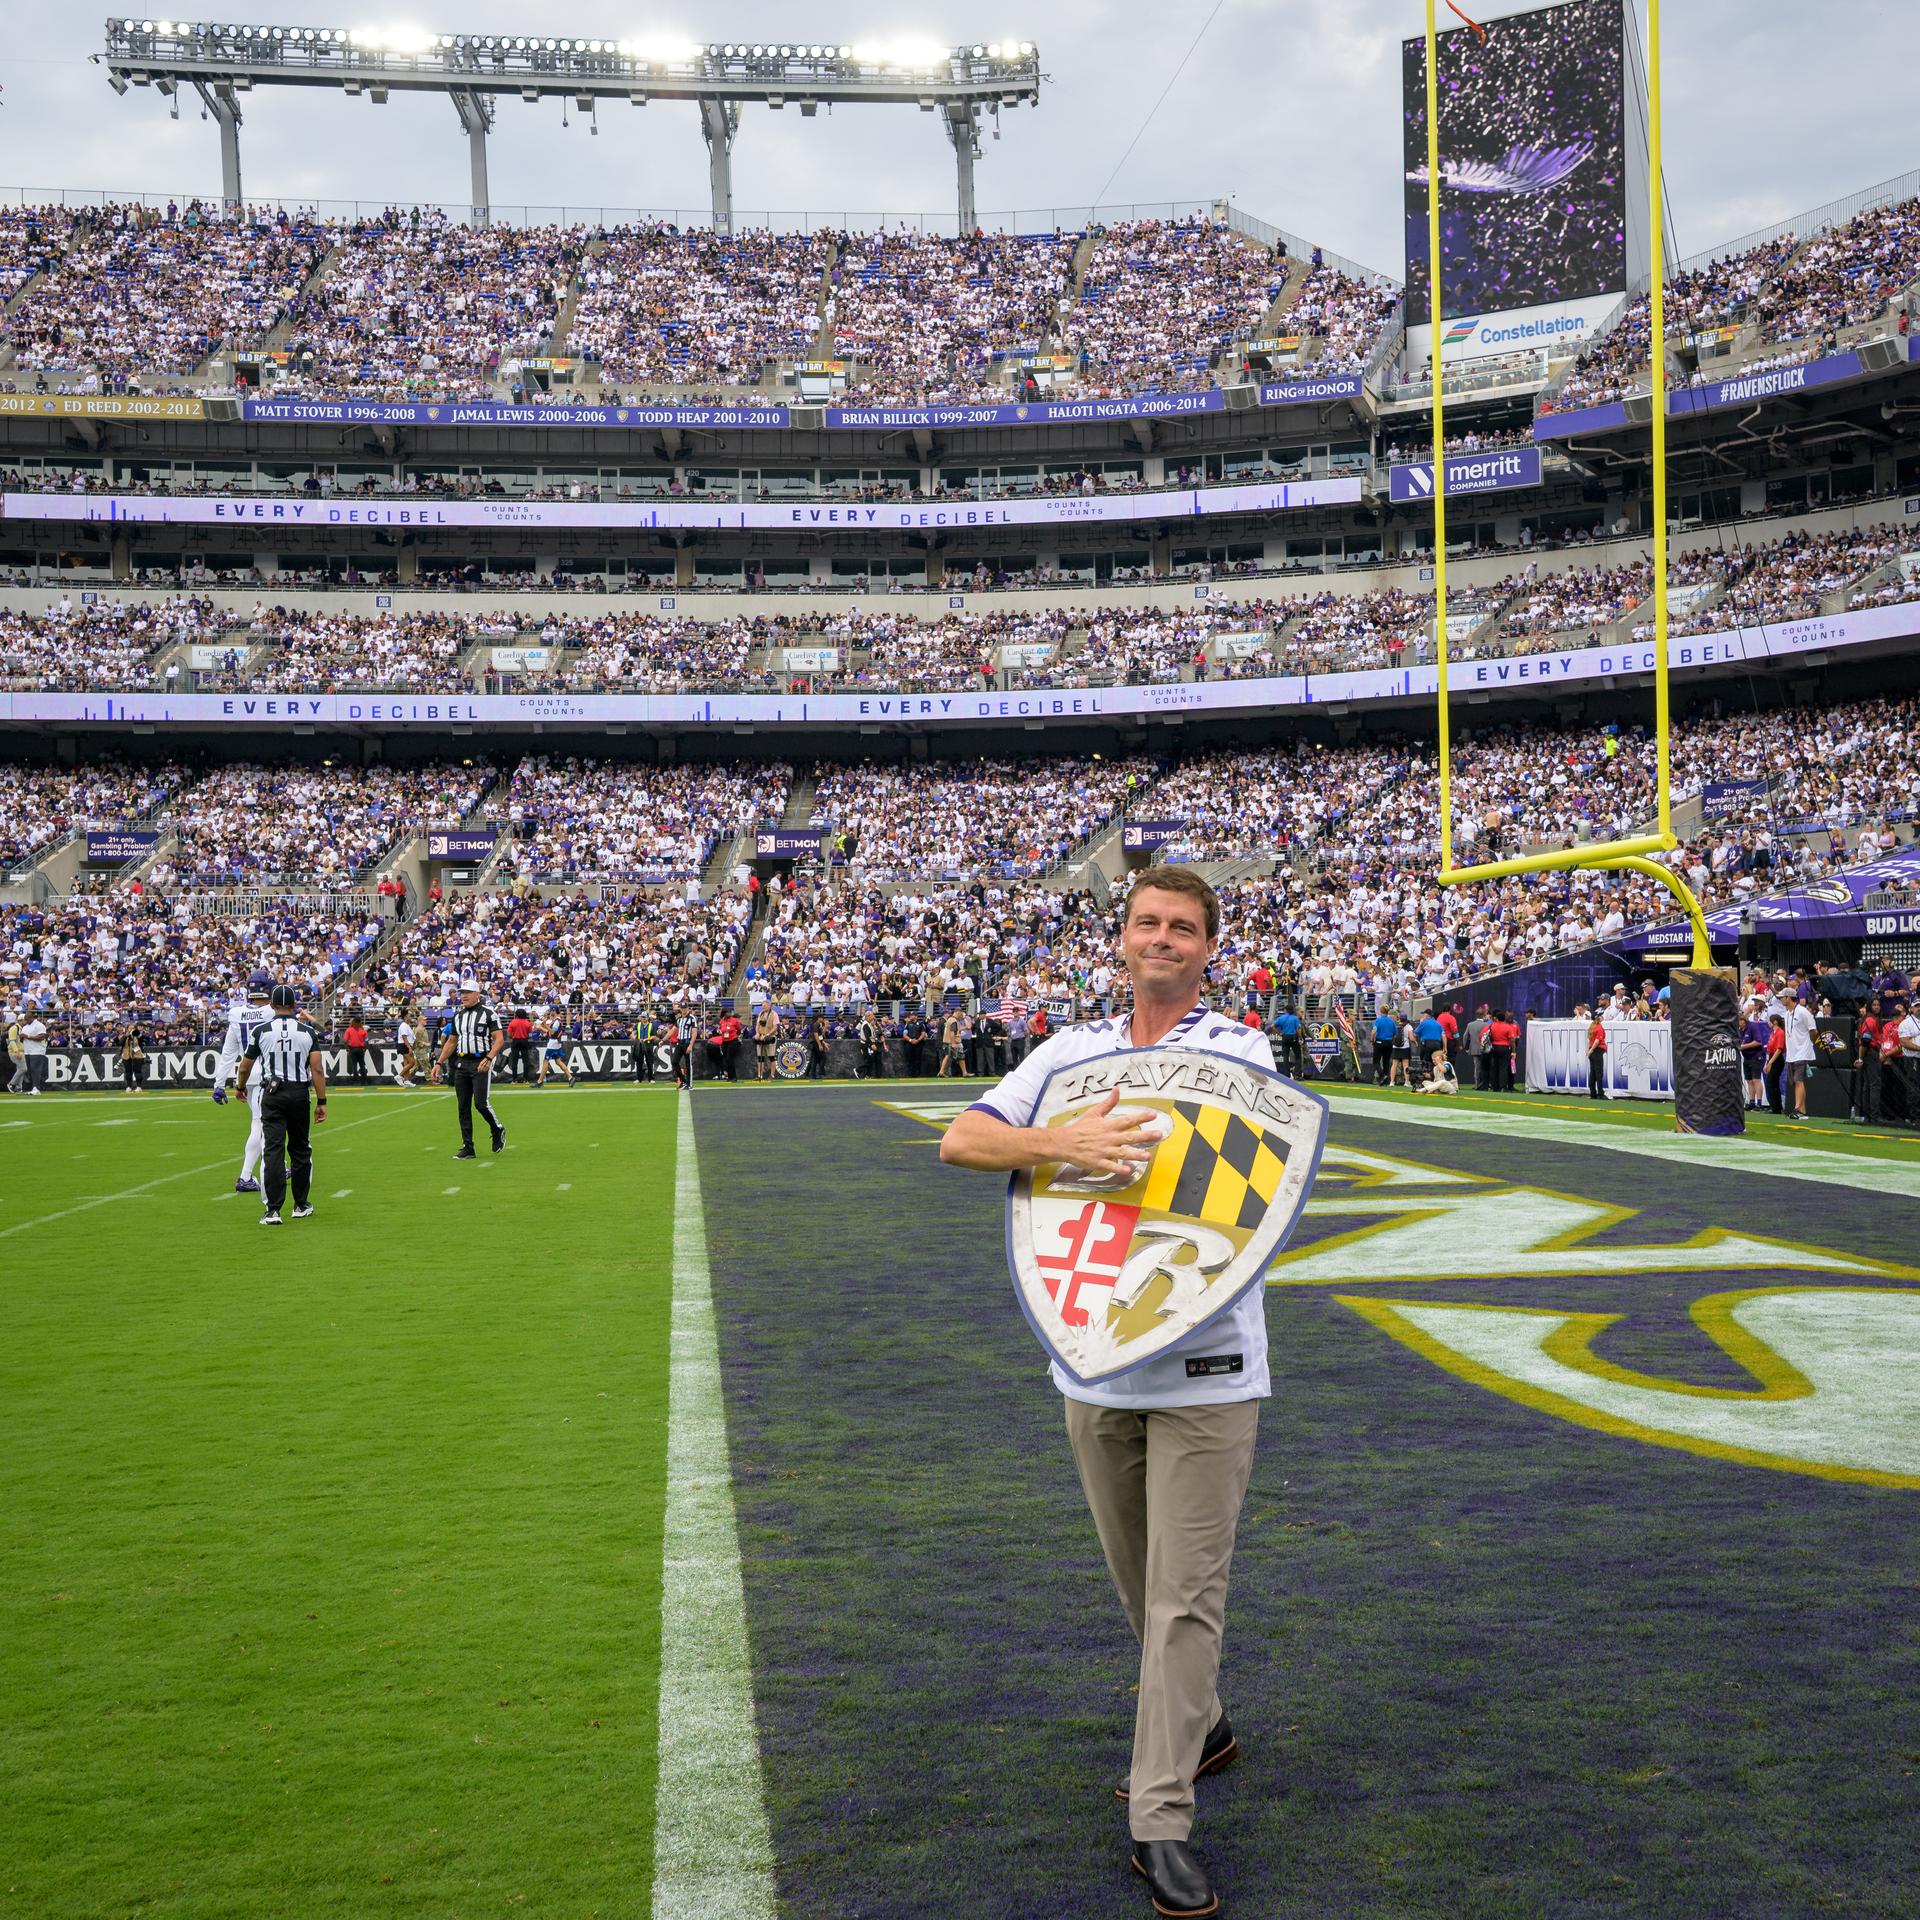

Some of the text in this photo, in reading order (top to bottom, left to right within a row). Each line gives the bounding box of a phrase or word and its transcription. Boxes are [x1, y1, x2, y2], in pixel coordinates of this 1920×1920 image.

[1480, 316, 1585, 344] Constellation
[522, 360, 536, 368] OLD
[794, 362, 808, 371] OLD
[1021, 358, 1036, 368] OLD
[1265, 387, 1297, 400] RING
[1306, 381, 1356, 397] HONOR
[1720, 367, 1805, 403] #RAVENSFLOCK
[64, 401, 200, 415] ED REED 2002-2012
[254, 405, 416, 420] MATT STOVER 1996-2008
[1048, 397, 1206, 418] HALOTI NGATA 2006-2014
[451, 409, 606, 422] JAMAL LEWIS 2000-2006
[637, 411, 780, 424] TODD HEAP 2001-2010
[842, 410, 998, 424] BRIAN BILLICK 1999-2007
[1449, 455, 1521, 482] merritt
[1449, 478, 1497, 491] COMPANIES
[1047, 501, 1091, 509] COUNTS
[215, 504, 446, 523] EVERY DECIBEL
[497, 513, 542, 521] COUNTS
[792, 509, 1011, 526] EVERY DECIBEL
[1060, 508, 1103, 516] COUNTS
[1782, 623, 1826, 636] COUNTS
[1792, 629, 1846, 645] COUNTS
[1476, 644, 1735, 681] EVERY DECBEL
[1143, 687, 1186, 696] COUNTS
[1155, 695, 1202, 705] COUNTS
[223, 701, 478, 719] EVERY DECIBEL
[859, 699, 1101, 716] EVERY DECIBEL
[449, 841, 493, 850] BETMGM
[776, 839, 820, 848] BETMGM
[1866, 917, 1897, 935] BUD
[1648, 932, 1684, 945] MEDSTAR
[523, 959, 531, 967] 52
[240, 1010, 263, 1020] MOORE
[277, 1039, 292, 1051] 11
[1704, 1048, 1737, 1065] LATINO
[1066, 1062, 1295, 1126] RAVENS
